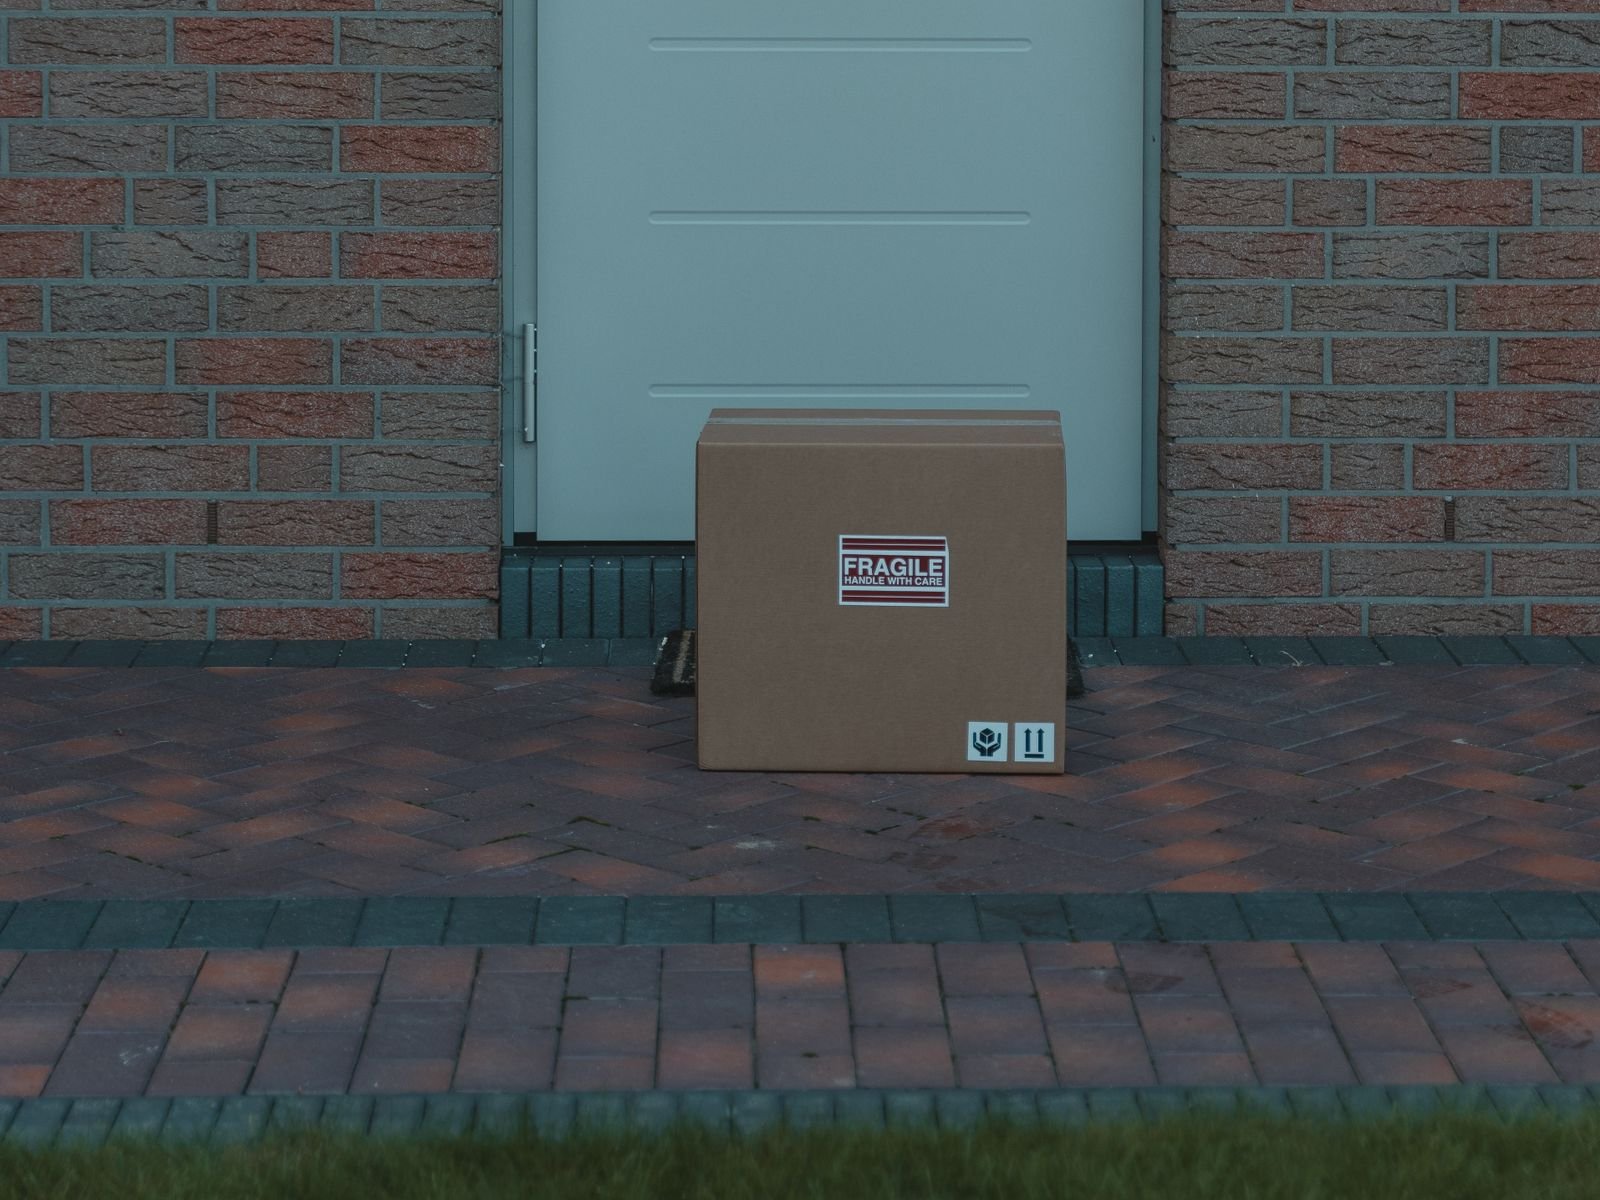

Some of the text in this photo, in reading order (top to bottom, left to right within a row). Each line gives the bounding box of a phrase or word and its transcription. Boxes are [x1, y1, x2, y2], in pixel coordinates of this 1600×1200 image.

[844, 557, 943, 576] FRAGILE
[844, 576, 943, 586] HANDLE WITH CARE
